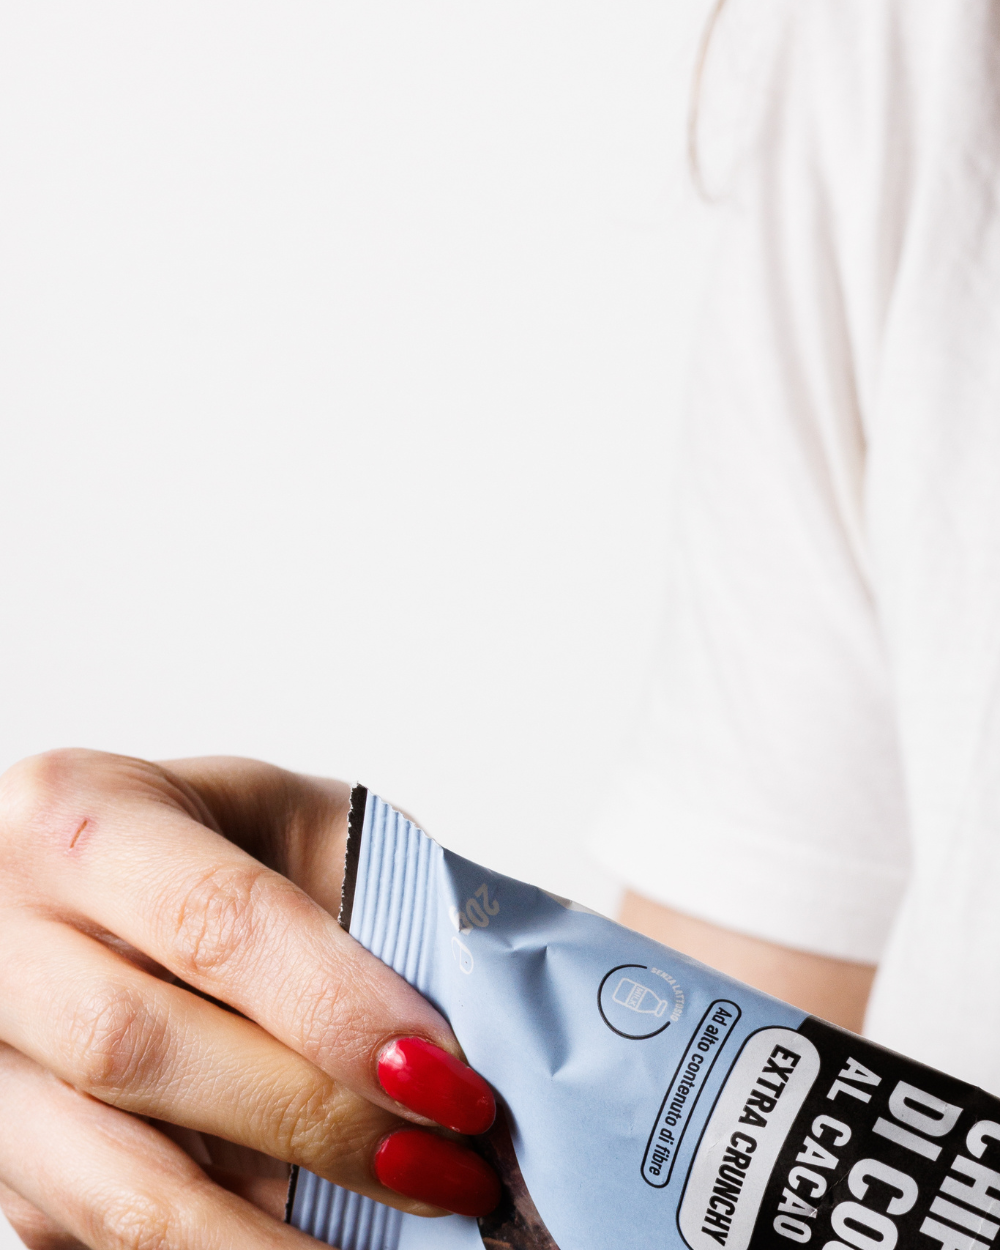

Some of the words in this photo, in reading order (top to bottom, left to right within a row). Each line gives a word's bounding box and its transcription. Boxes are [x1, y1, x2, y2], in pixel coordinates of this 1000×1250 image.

[628, 987, 644, 1007] MILK
[650, 967, 677, 986] SENZA
[669, 984, 685, 1022] LATTOSIO
[711, 1007, 733, 1027] Ad
[697, 1024, 719, 1053] alto
[664, 1053, 704, 1127] contenuto
[737, 1044, 802, 1128] EXTRA
[826, 1056, 883, 1104] AL
[658, 1128, 675, 1146] di
[871, 1080, 964, 1162] DI
[648, 1144, 671, 1177] fibre
[773, 1114, 852, 1244] CACAO
[701, 1131, 758, 1247] CRUNCHY
